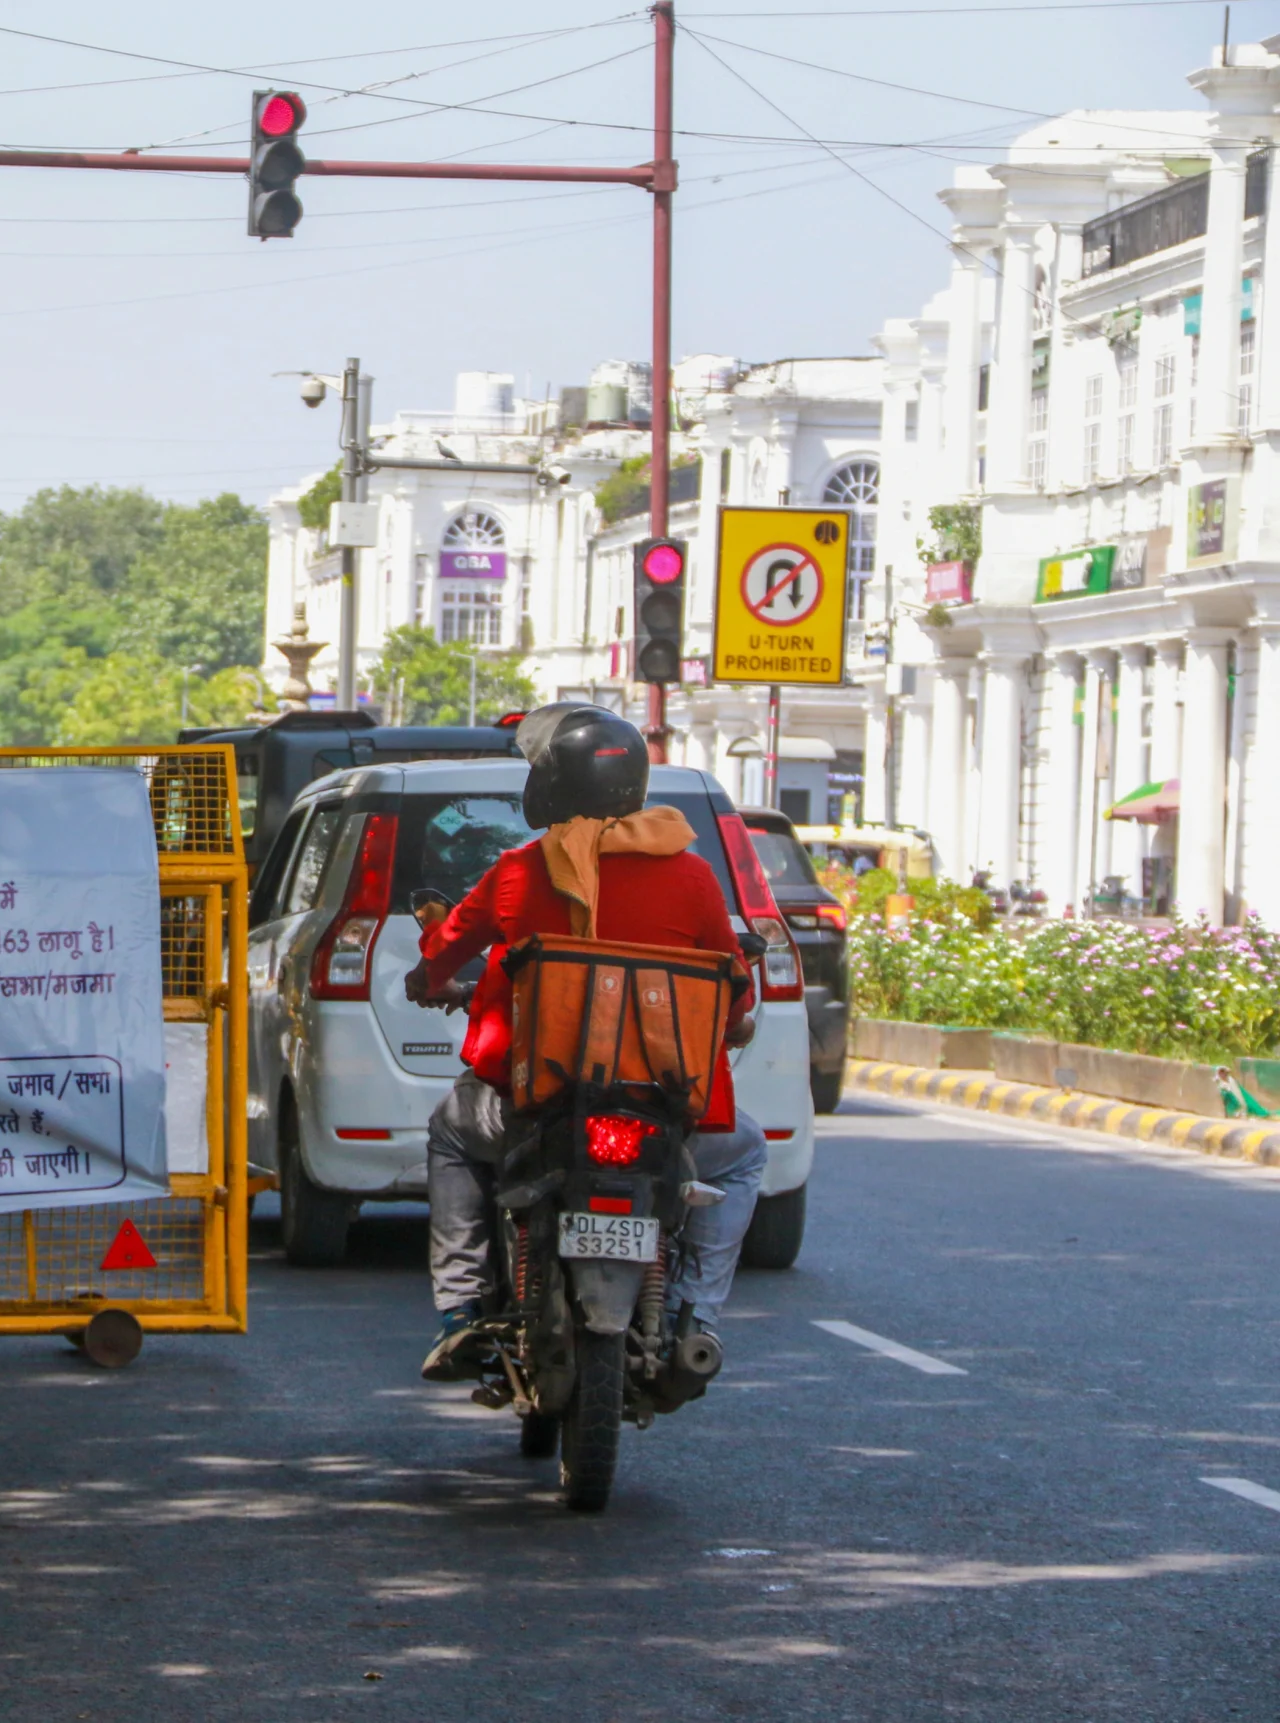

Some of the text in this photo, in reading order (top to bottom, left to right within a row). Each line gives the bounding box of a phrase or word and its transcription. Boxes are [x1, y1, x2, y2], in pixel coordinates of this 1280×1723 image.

[749, 635, 814, 650] U-TURN
[725, 655, 831, 672] PROHIBITED
[37, 930, 83, 959] लागू
